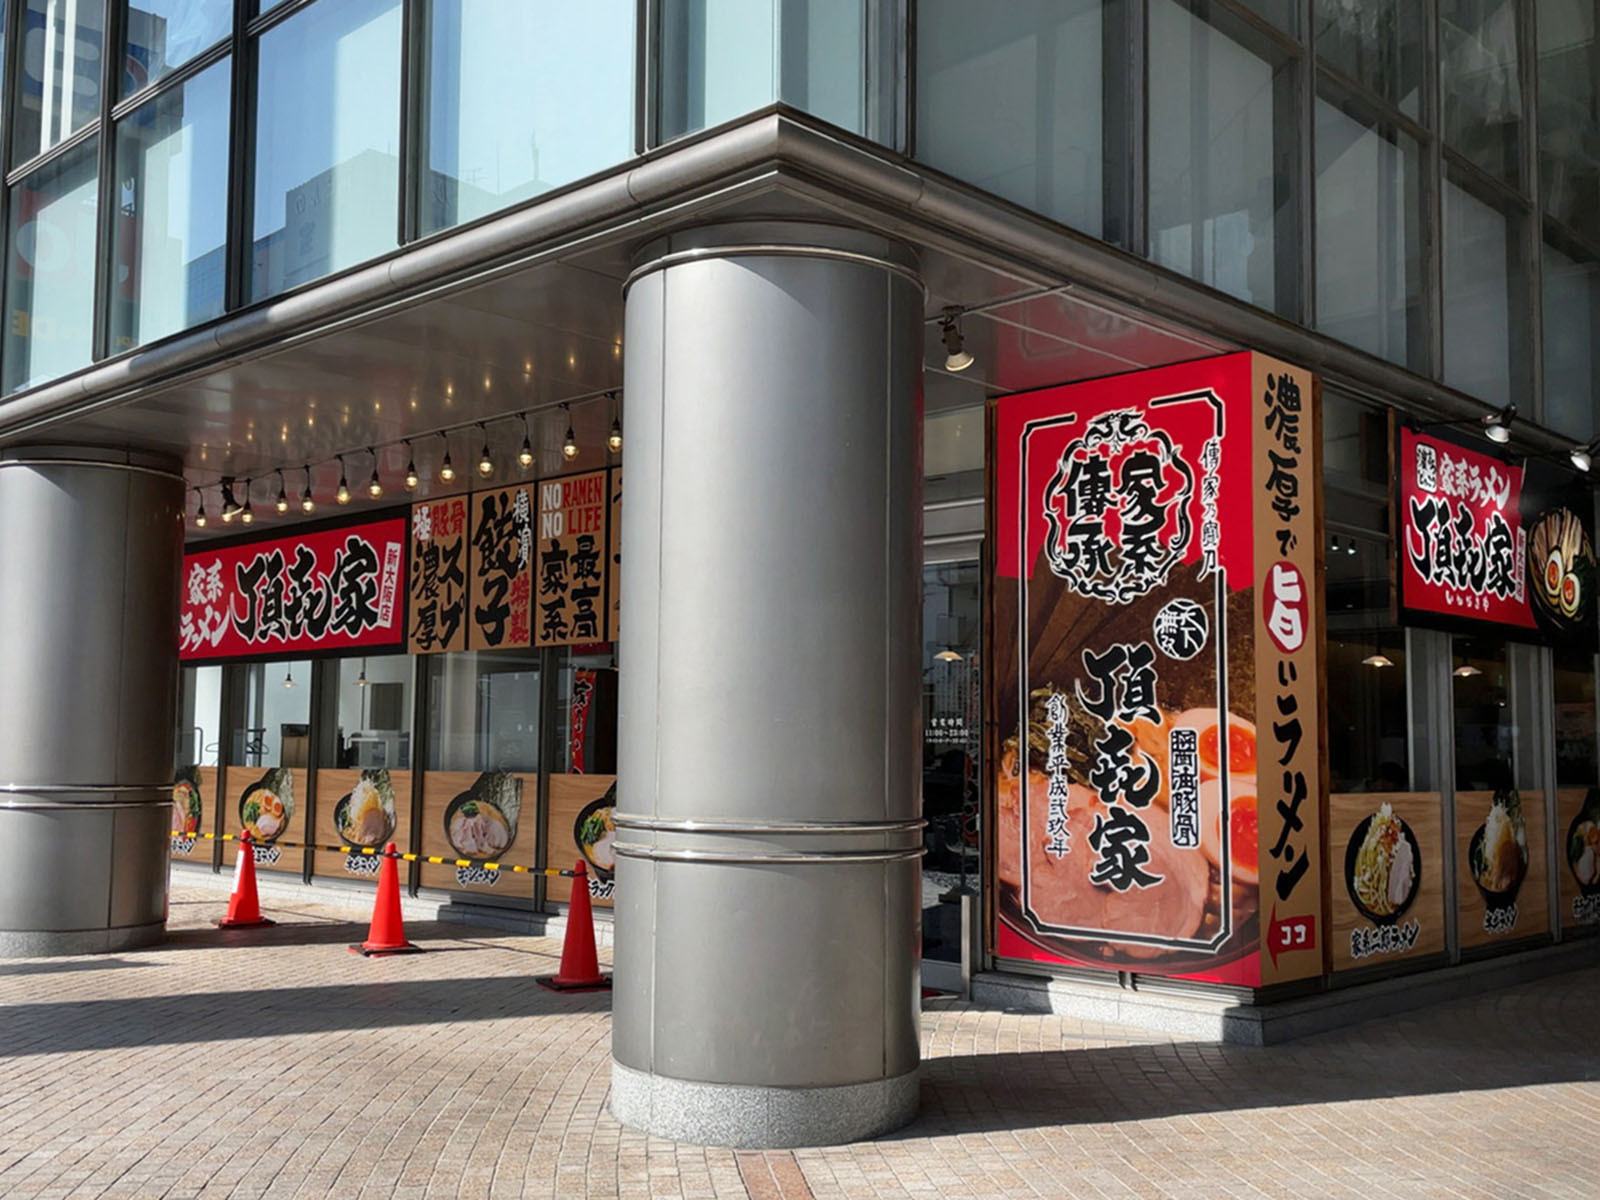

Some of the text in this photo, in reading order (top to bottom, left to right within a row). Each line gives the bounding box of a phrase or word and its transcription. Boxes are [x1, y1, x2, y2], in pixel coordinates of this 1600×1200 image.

[542, 476, 602, 510] NO RAMEN
[542, 506, 601, 539] NO LIFE
[411, 540, 440, 650] 濃厚
[438, 535, 465, 648] スープ
[473, 491, 521, 646] 餃子
[540, 538, 569, 641] 家系
[570, 534, 600, 638] 最高
[1281, 924, 1306, 945] ココ
